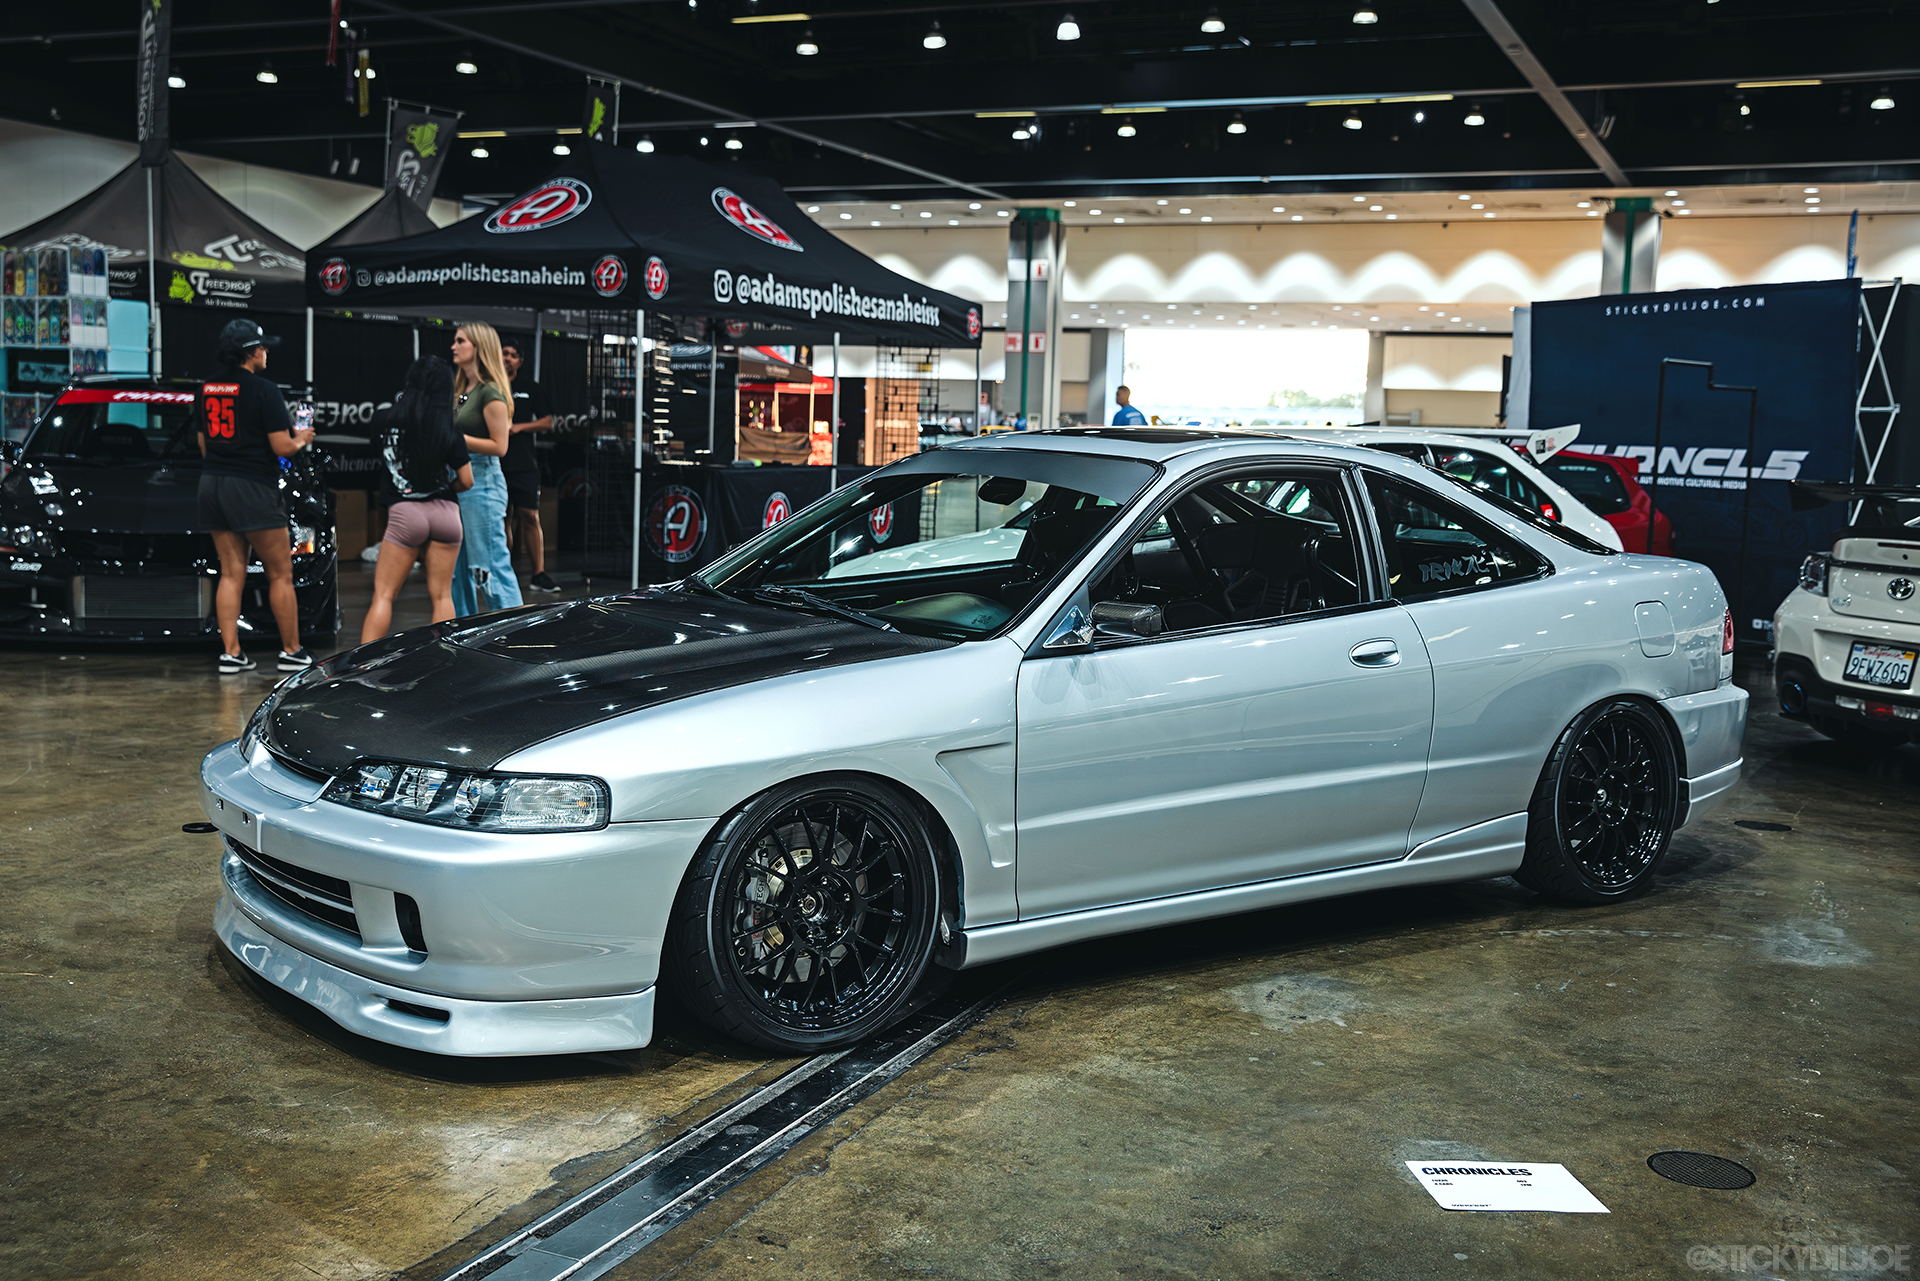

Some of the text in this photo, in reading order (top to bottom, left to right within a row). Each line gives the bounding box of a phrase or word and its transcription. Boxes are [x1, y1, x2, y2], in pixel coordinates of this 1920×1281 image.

[374, 262, 586, 287] @adamspolishesanaheim
[736, 272, 940, 327] @adamspolishesanaheim
[1605, 297, 1766, 317] STICKYDILJOE.COM
[206, 396, 235, 439] 35
[1639, 476, 1685, 487] AUTMOTIVE
[1849, 657, 1909, 683] 9FWZ605
[1421, 1167, 1533, 1176] CHRONICLES
